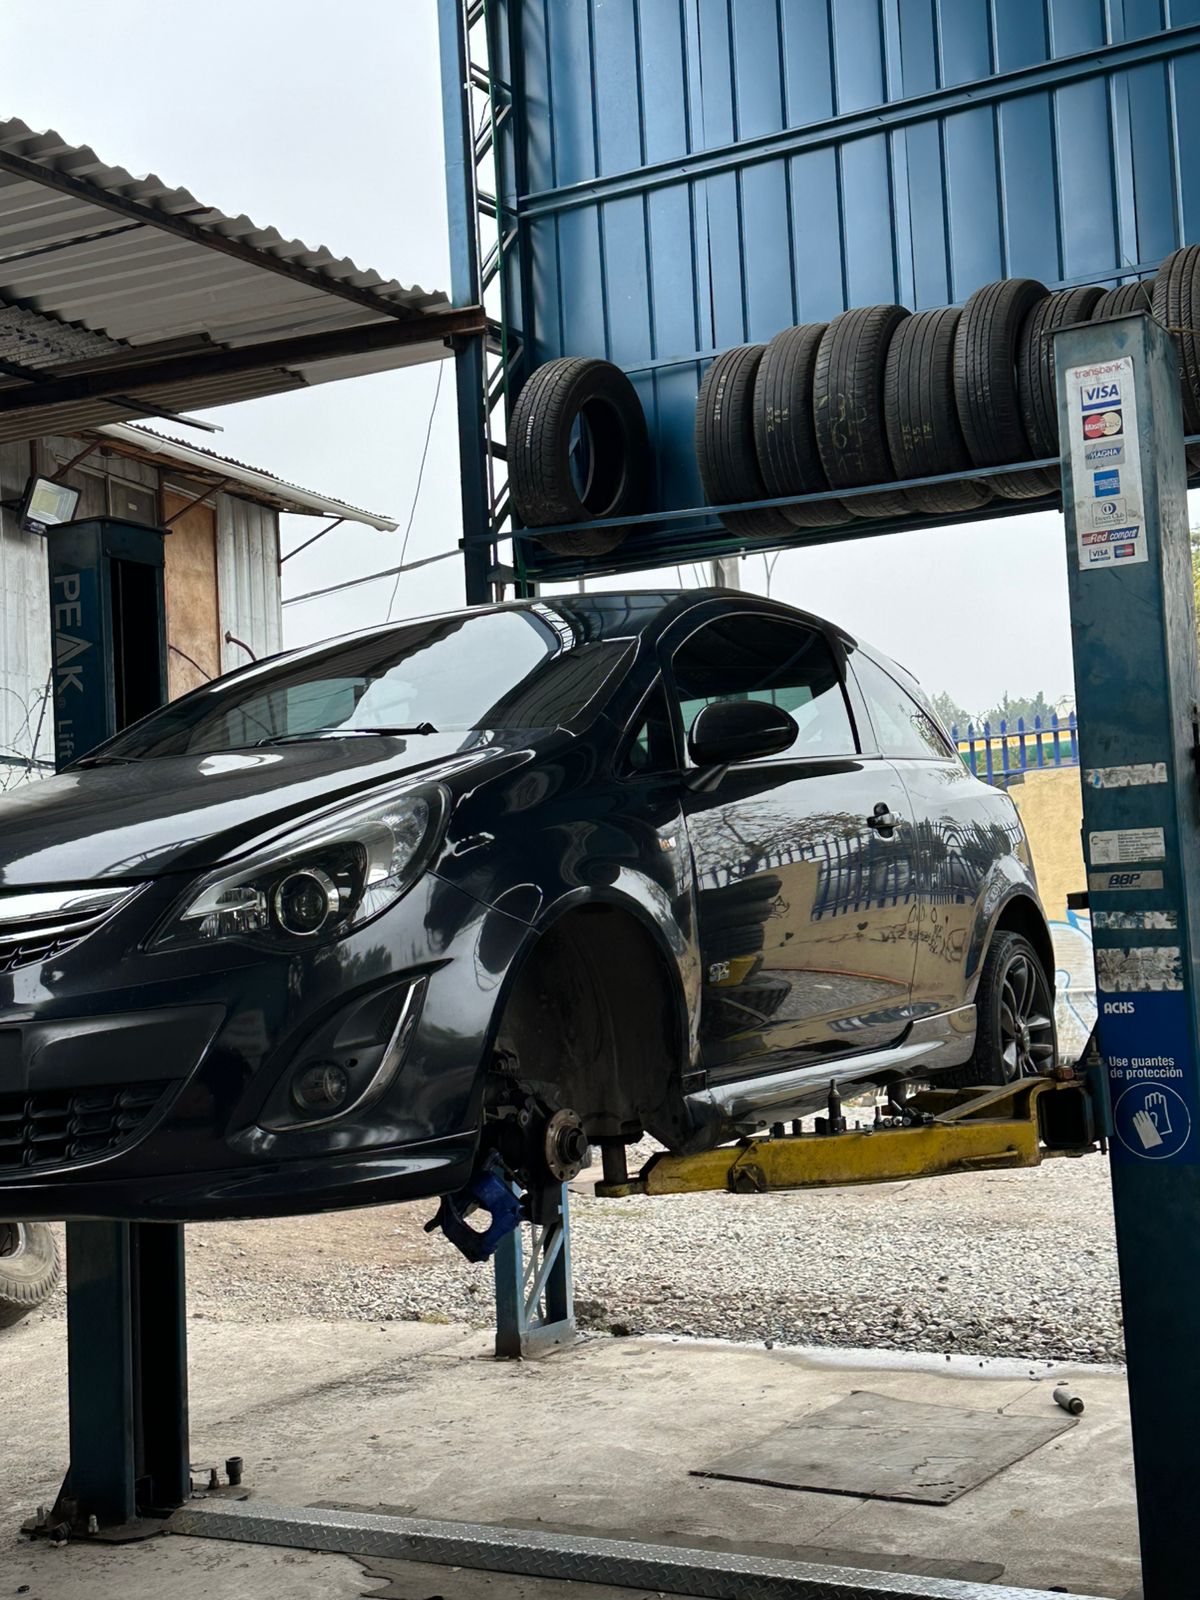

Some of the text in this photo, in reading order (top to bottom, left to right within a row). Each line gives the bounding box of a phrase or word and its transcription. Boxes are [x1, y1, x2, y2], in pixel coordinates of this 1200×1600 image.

[1074, 363, 1122, 379] transbank
[1086, 384, 1118, 400] VISA
[1091, 532, 1108, 543] Red
[1092, 549, 1109, 557] VISA
[53, 573, 94, 694] PEAK
[57, 719, 75, 758] Lift
[1109, 873, 1141, 884] BBP
[1103, 1002, 1135, 1014] ACHS
[1108, 1055, 1175, 1068] Use guantes
[1110, 1066, 1183, 1080] de protección
